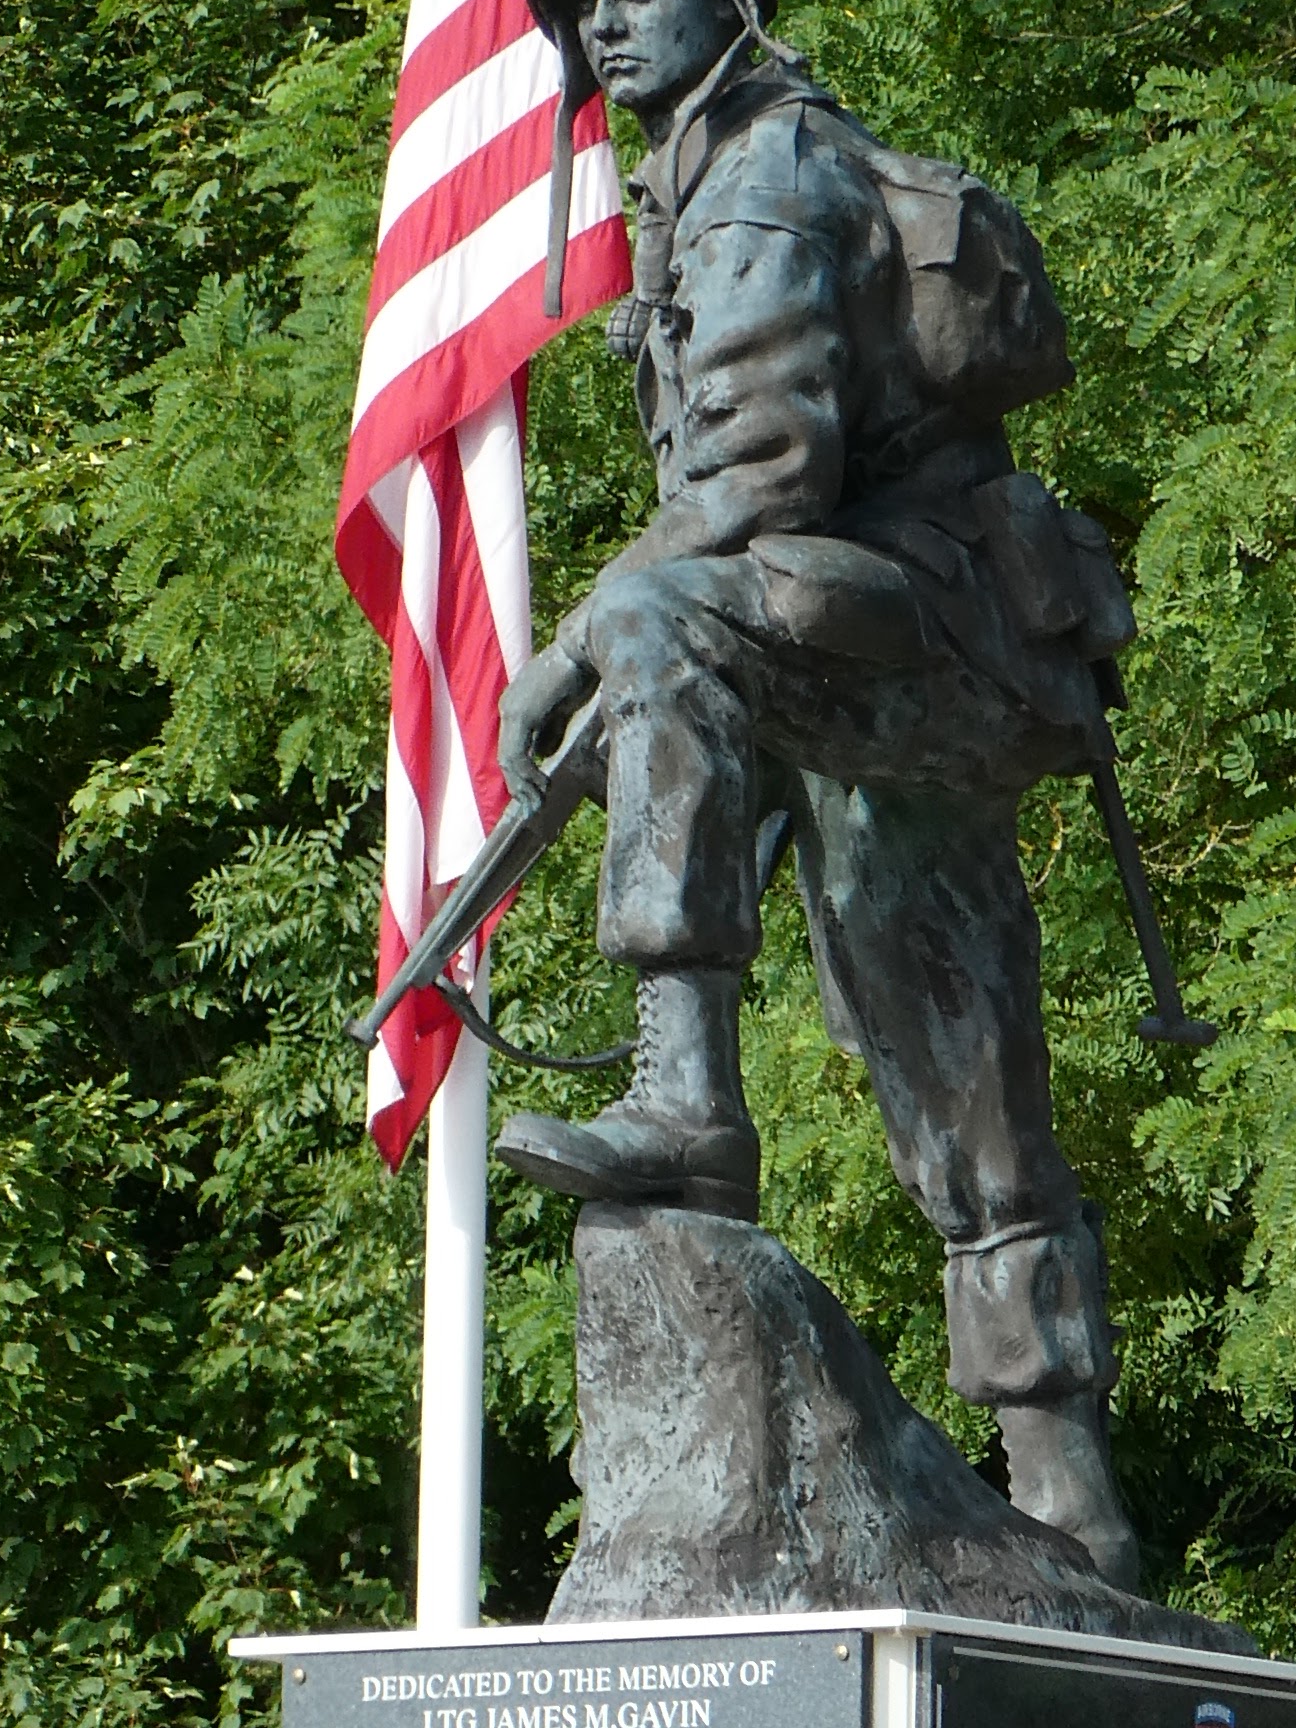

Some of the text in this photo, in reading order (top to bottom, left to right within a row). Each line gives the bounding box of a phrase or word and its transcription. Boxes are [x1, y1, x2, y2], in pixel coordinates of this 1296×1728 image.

[362, 1659, 776, 1702] DEDICATED TO THE MEMORY OF
